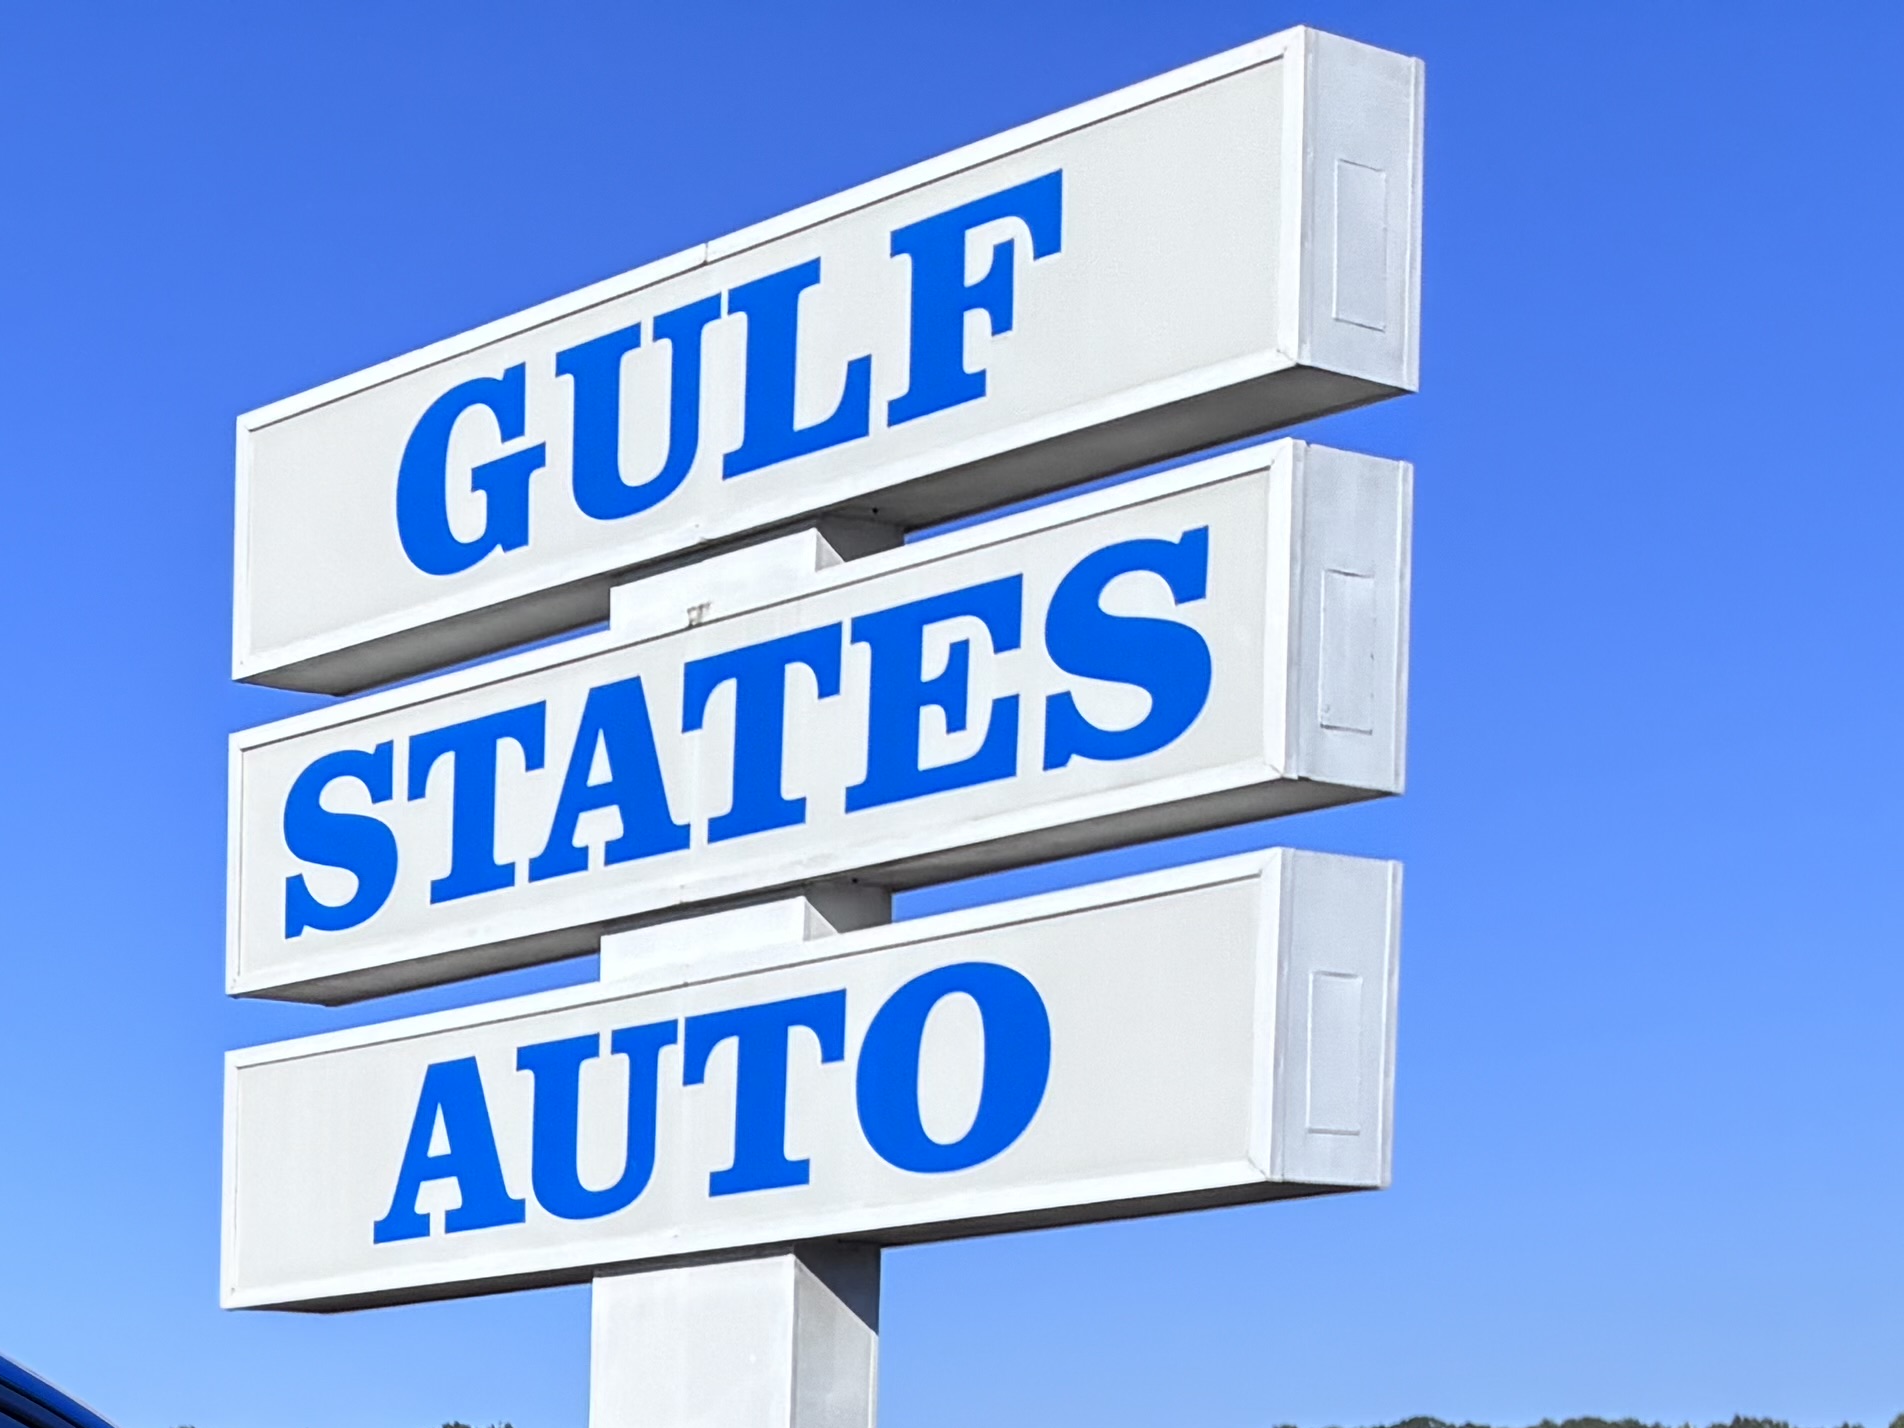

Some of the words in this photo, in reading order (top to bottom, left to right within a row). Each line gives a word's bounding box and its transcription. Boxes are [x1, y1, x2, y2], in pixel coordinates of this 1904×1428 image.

[395, 168, 1063, 577] GULF
[282, 524, 1213, 939] STATES
[373, 961, 1052, 1245] AUTO
